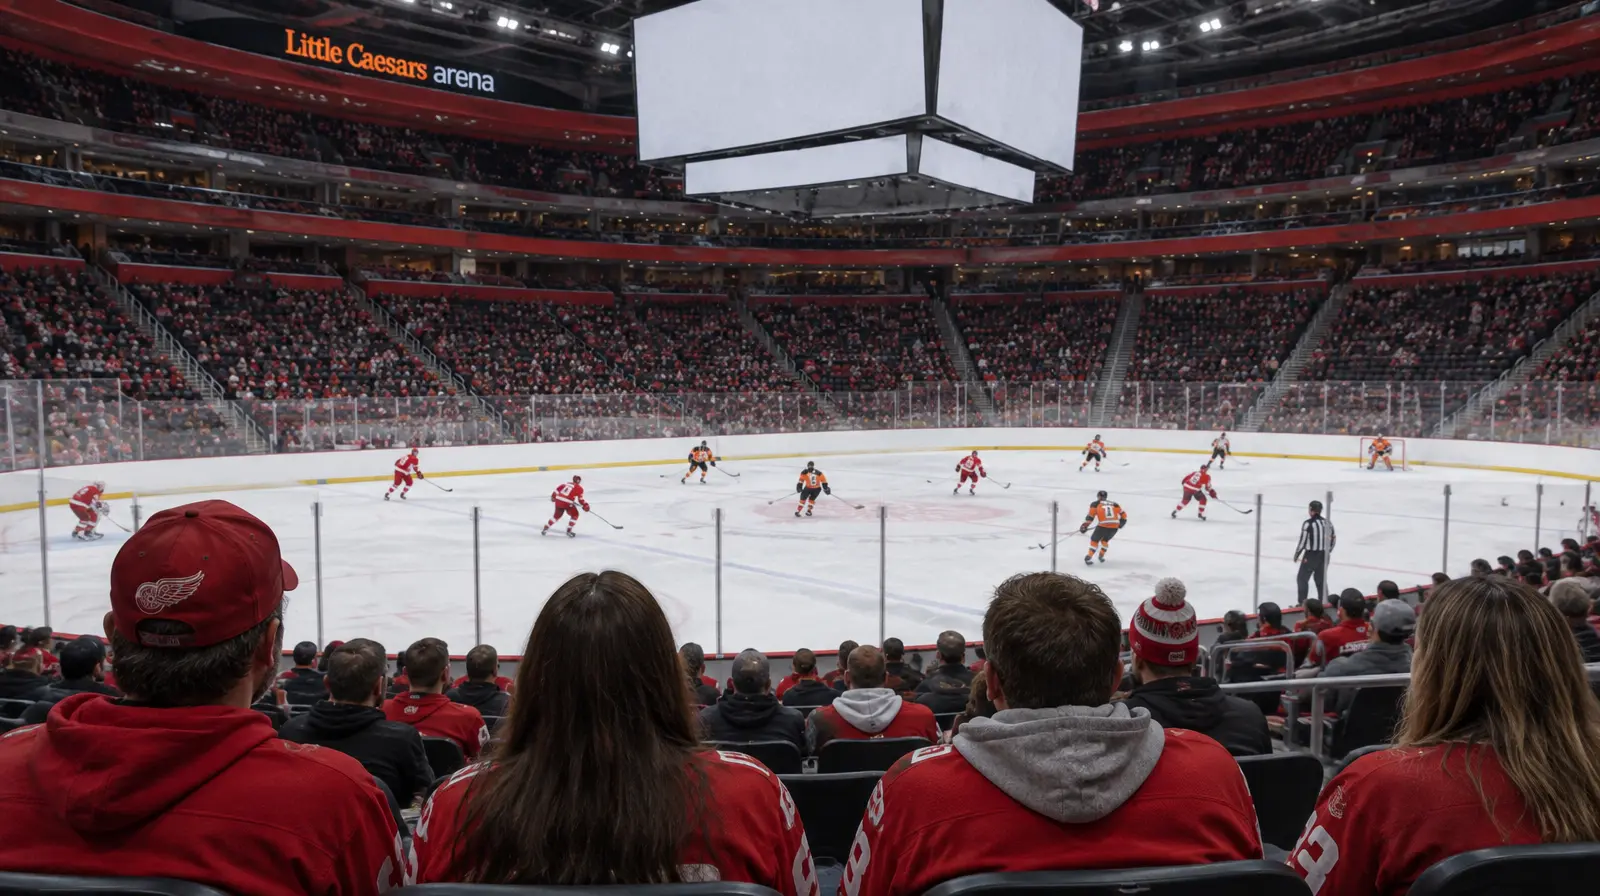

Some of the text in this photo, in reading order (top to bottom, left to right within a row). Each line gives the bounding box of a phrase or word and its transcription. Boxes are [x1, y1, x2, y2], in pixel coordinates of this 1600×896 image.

[285, 28, 494, 92] Little Caesars arena
